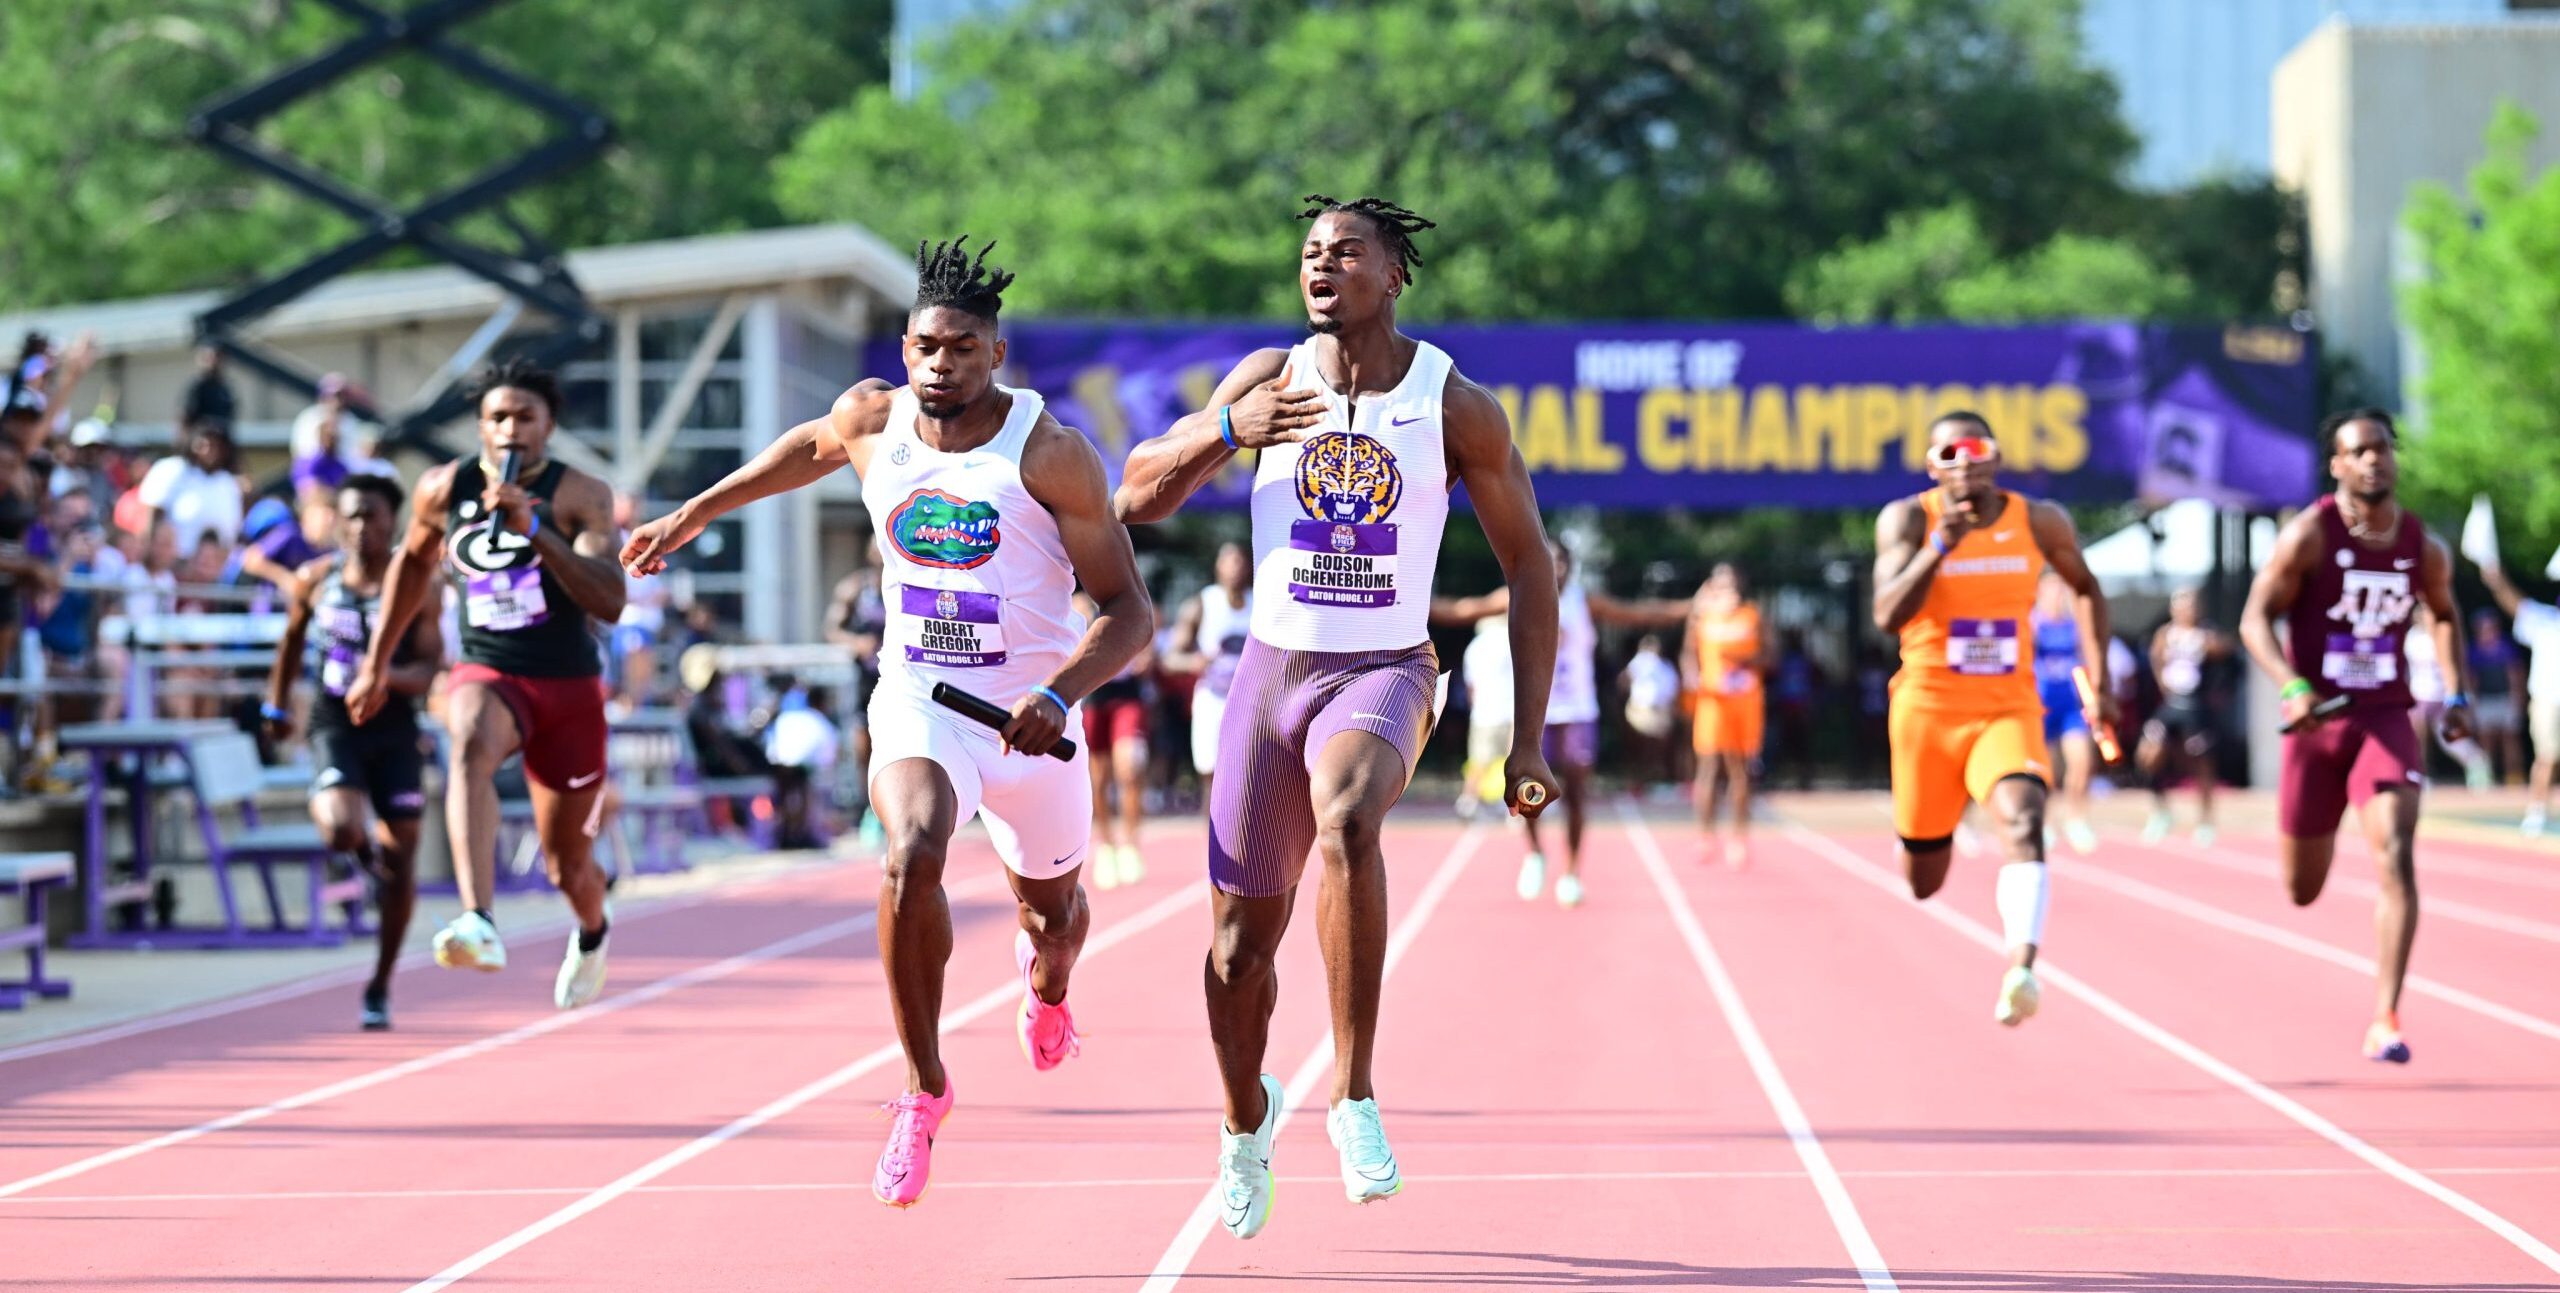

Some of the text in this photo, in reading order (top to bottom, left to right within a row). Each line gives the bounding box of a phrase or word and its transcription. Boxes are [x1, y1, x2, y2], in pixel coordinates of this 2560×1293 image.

[1576, 340, 1745, 392] HOME OF
[1333, 533, 1354, 541] TRACK
[1313, 554, 1373, 573] GODSON
[1292, 567, 1394, 589] OGHENEBRUME
[1308, 590, 1334, 600] BATON
[1364, 594, 1374, 603] LA
[924, 619, 975, 638] ROBERT
[921, 634, 981, 652] GREGORY
[923, 652, 946, 663] BATON
[974, 656, 984, 664] LA
